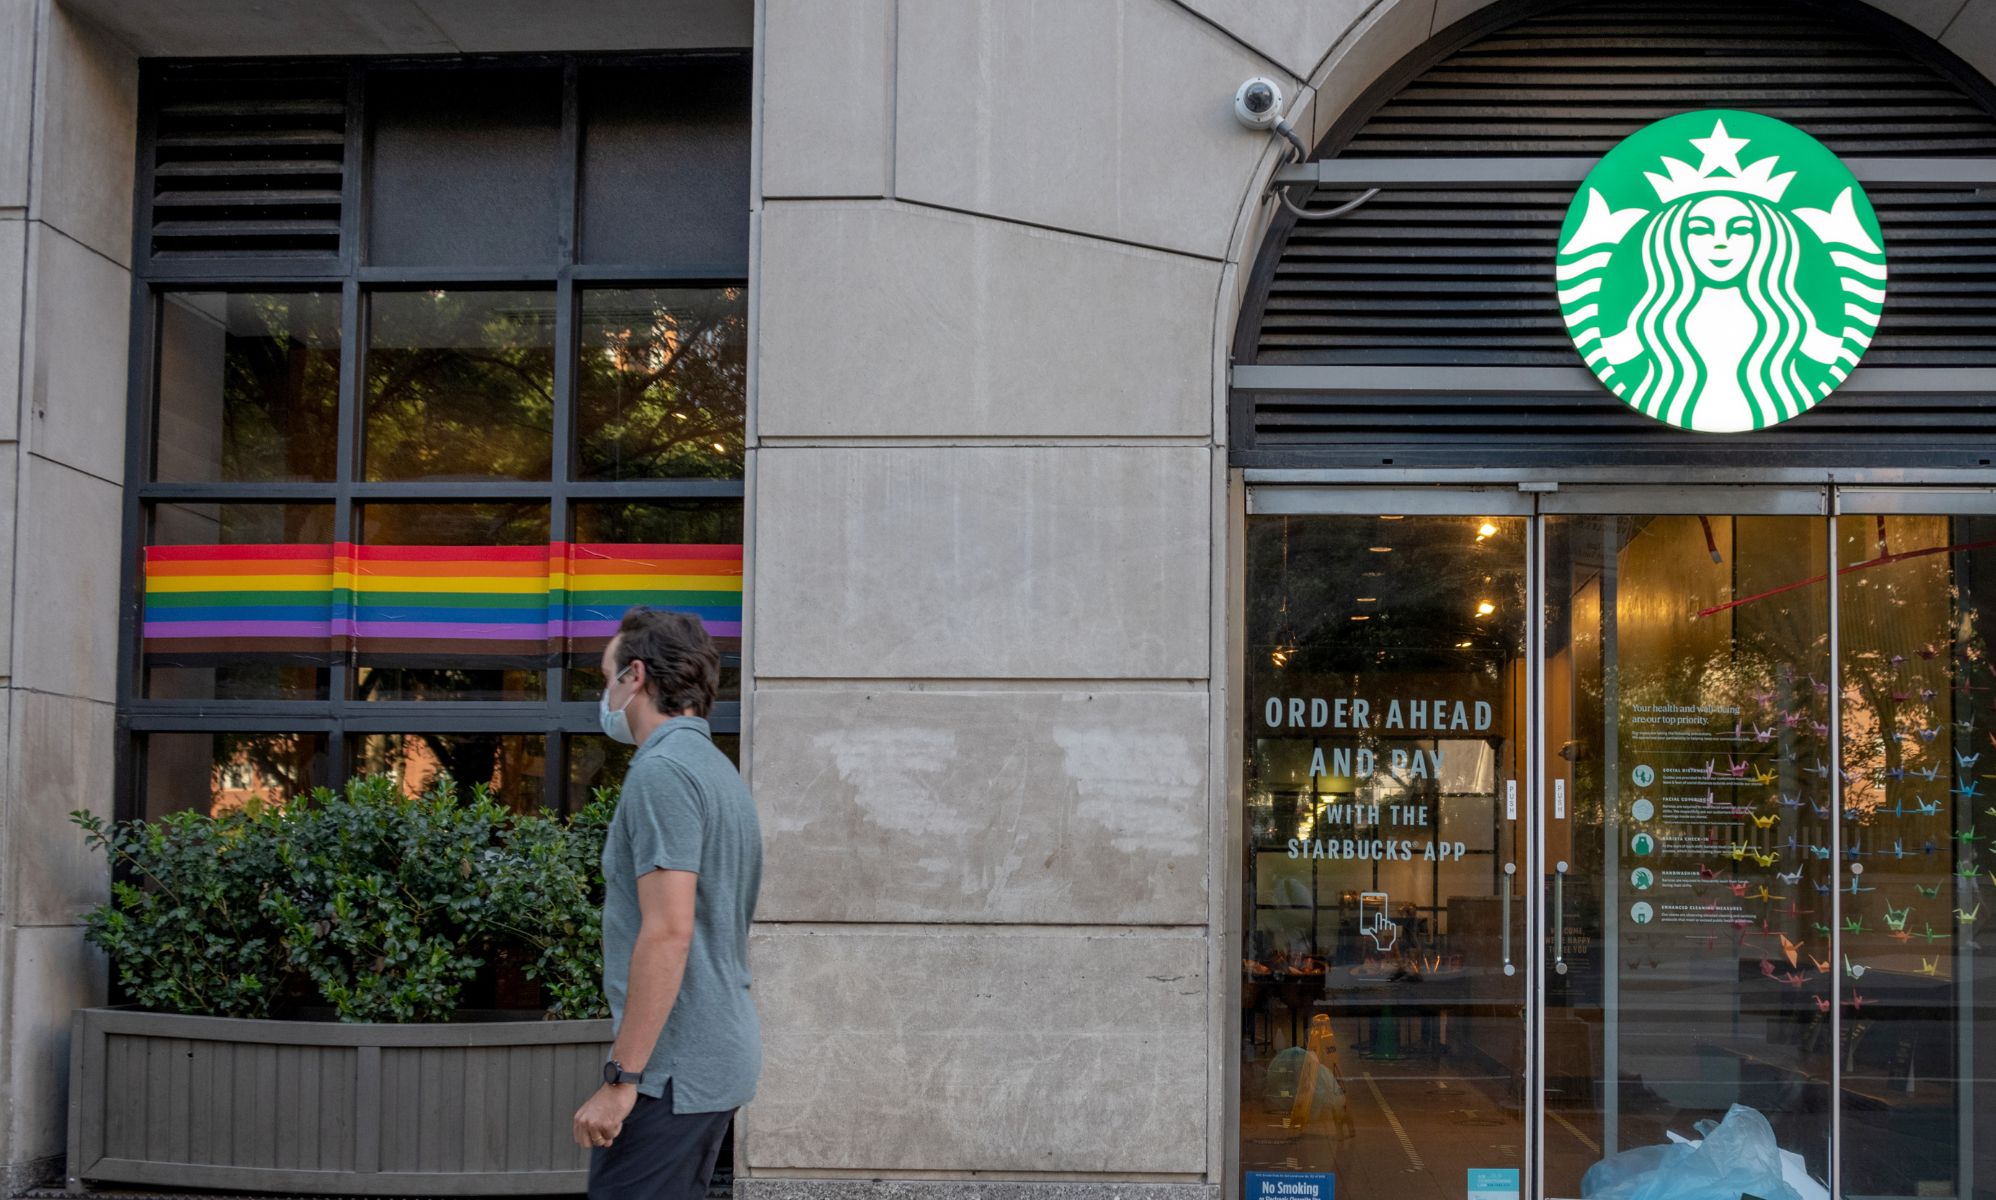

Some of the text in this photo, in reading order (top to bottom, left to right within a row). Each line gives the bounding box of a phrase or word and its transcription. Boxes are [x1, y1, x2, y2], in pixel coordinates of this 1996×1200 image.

[1265, 697, 1492, 730] ORDER AHEAD
[1632, 704, 1651, 712] Your
[1653, 704, 1678, 712] health
[1680, 704, 1695, 713] and
[1662, 716, 1676, 725] top
[1677, 715, 1709, 725] priority.
[1309, 748, 1445, 779] AND PAY
[1326, 804, 1428, 826] WITH THE
[1423, 841, 1466, 862] APP
[1262, 1181, 1319, 1196] No Smoking
